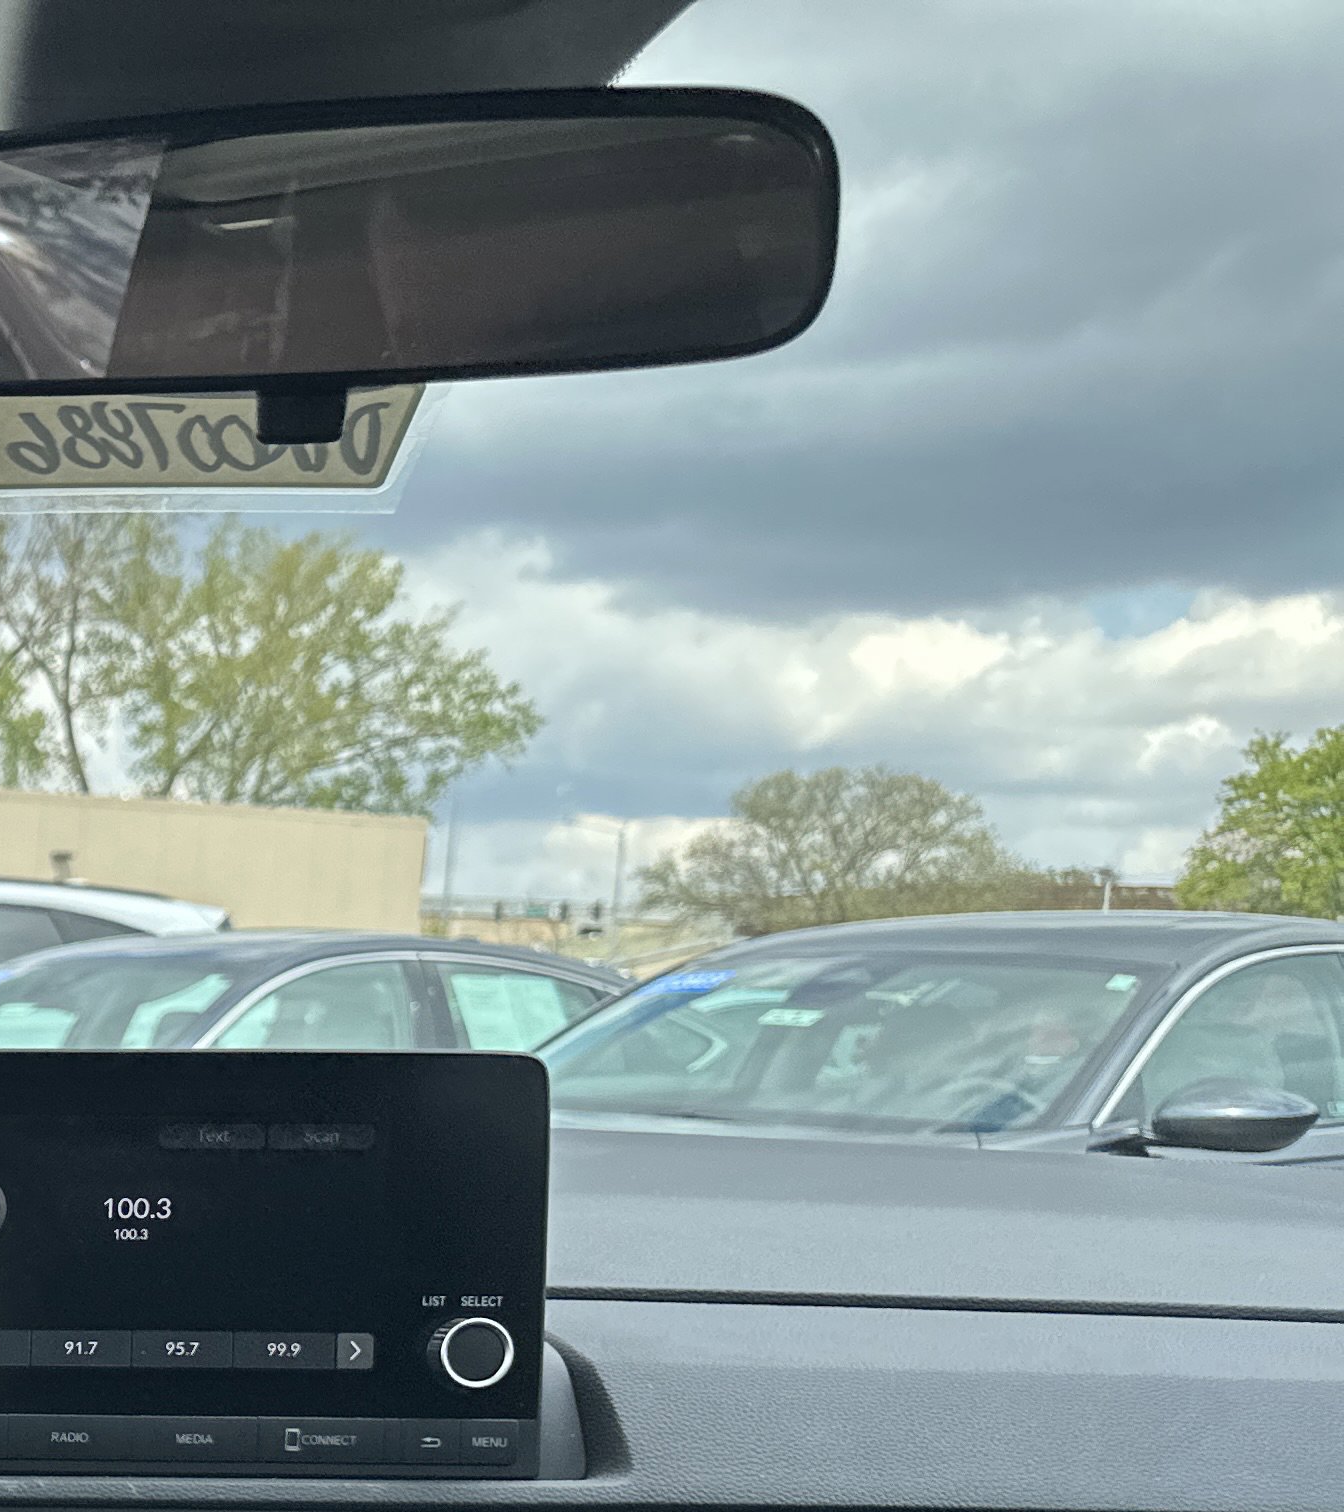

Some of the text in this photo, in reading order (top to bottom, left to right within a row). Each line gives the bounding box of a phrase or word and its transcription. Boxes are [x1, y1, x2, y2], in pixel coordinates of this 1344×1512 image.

[103, 1197, 172, 1220] 100.3
[113, 1227, 149, 1242] 100.3
[421, 1295, 504, 1307] LIST SELECT
[64, 1340, 99, 1356] 91.7
[165, 1341, 200, 1357] 95.7
[266, 1342, 302, 1358] 99.9
[49, 1431, 90, 1443] RADIO
[175, 1433, 214, 1445] MEDIA
[300, 1434, 357, 1446] CONNECT
[471, 1436, 508, 1448] MENU
